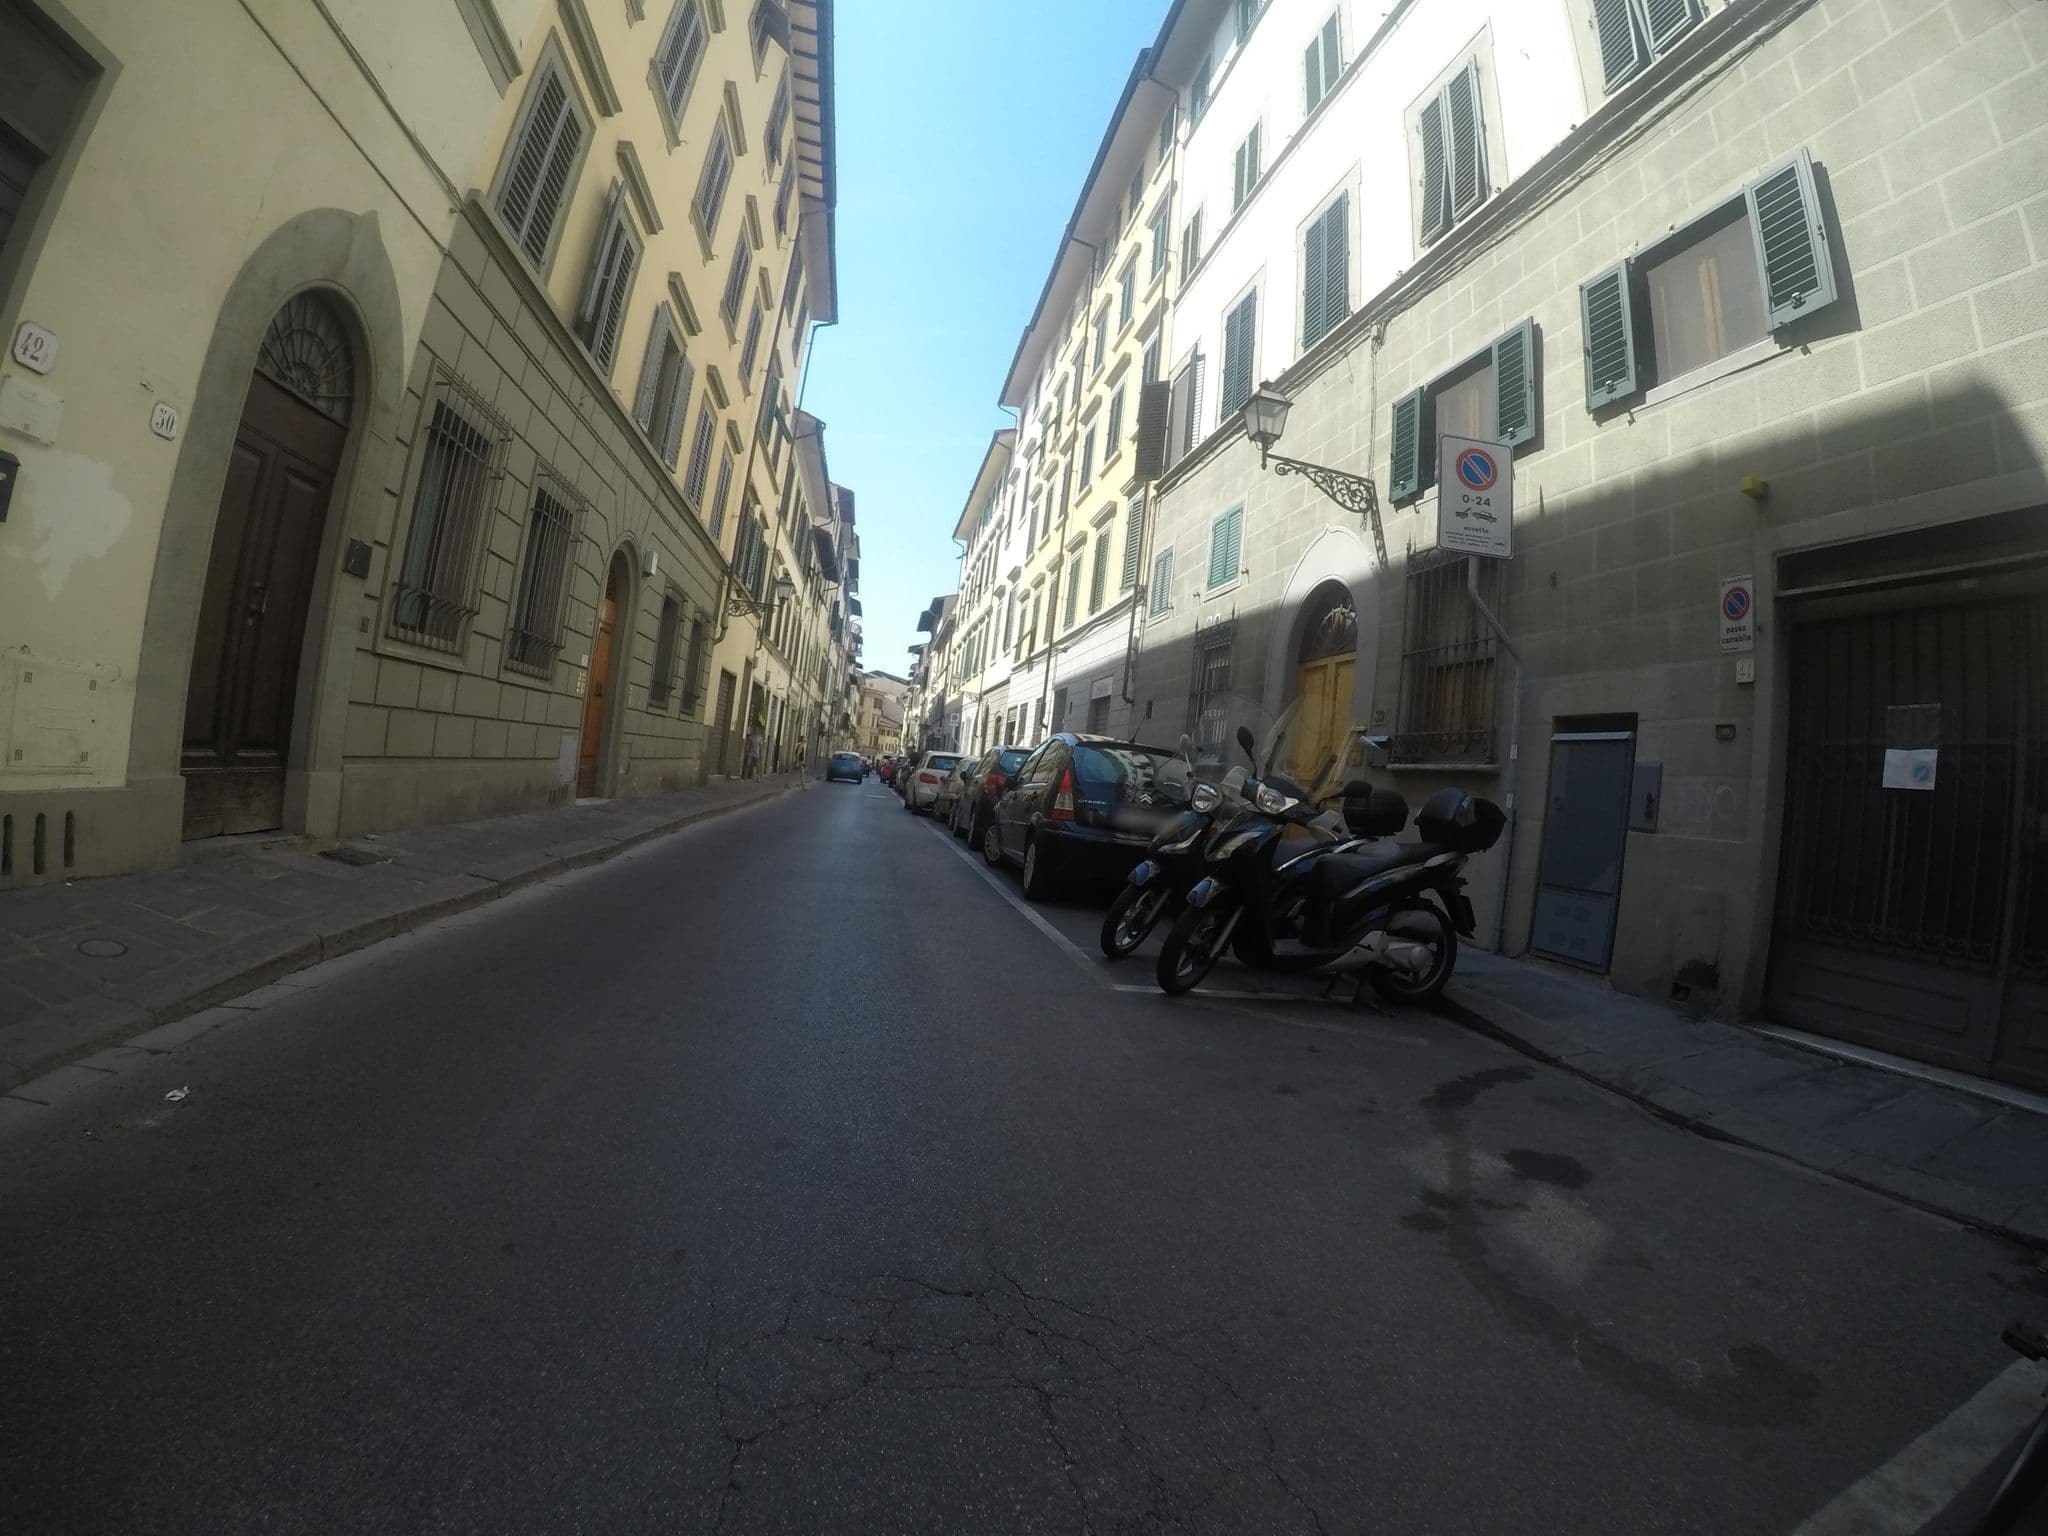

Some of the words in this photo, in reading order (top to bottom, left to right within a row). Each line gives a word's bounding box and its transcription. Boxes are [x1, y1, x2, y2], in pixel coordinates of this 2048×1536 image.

[20, 332, 45, 362] 42
[155, 408, 176, 433] 50
[1462, 494, 1491, 507] 0-24
[1463, 526, 1489, 534] eccetto
[1726, 625, 1747, 635] passo
[1721, 634, 1752, 645] carrabile
